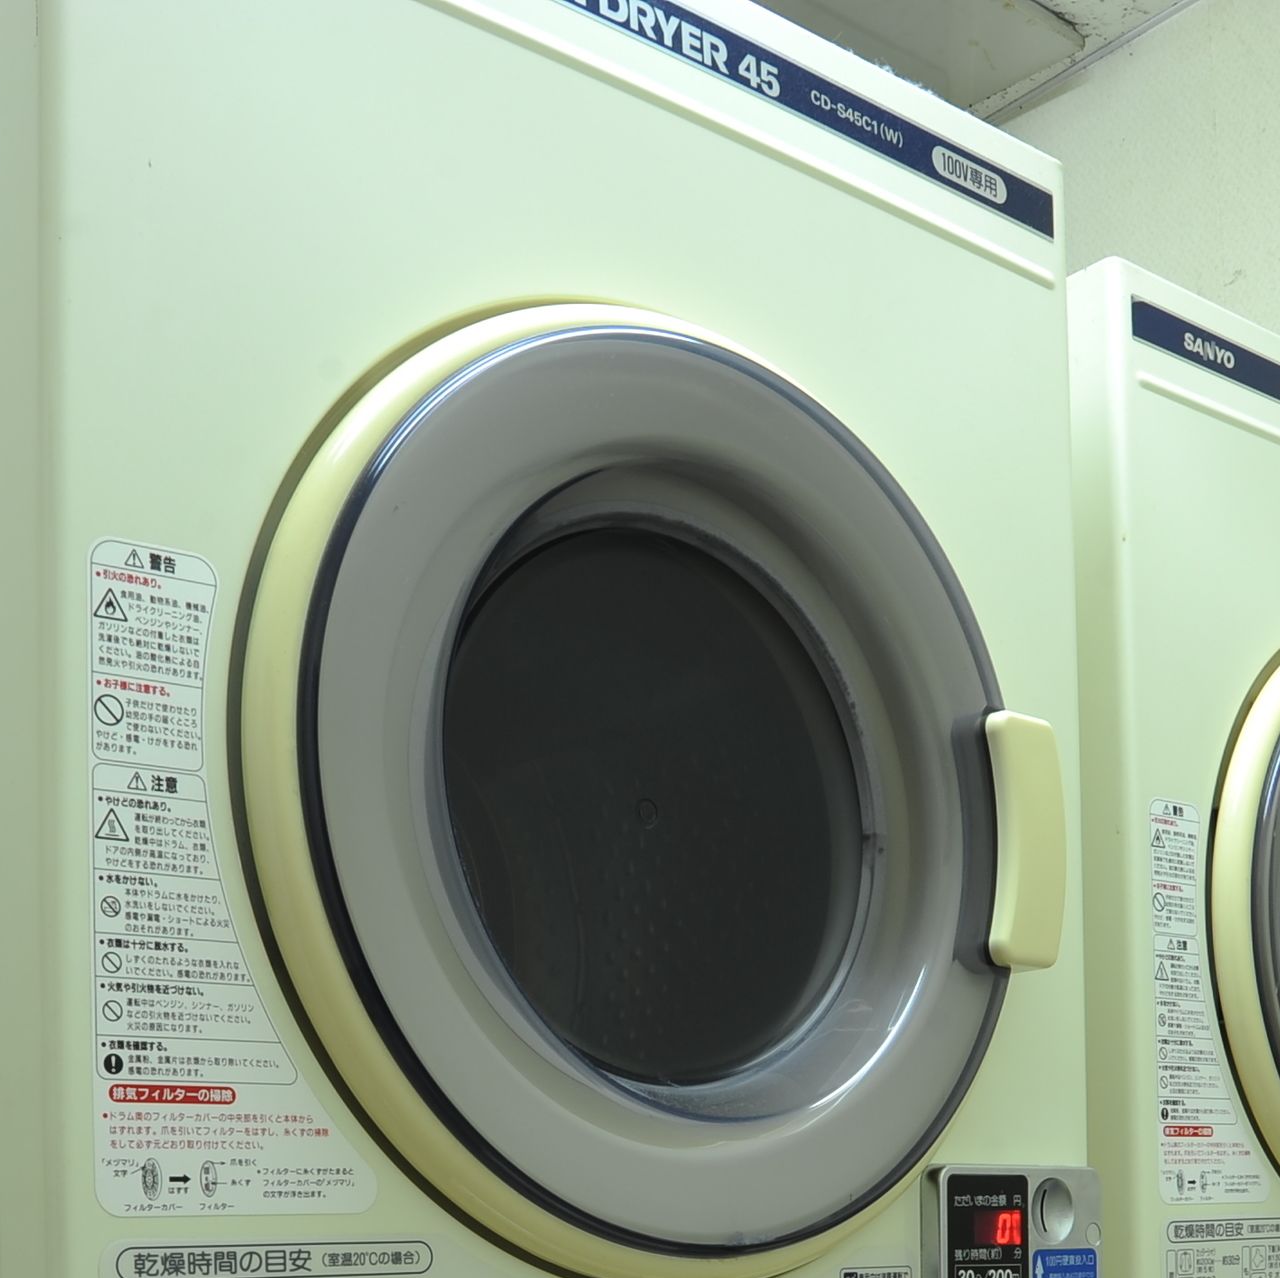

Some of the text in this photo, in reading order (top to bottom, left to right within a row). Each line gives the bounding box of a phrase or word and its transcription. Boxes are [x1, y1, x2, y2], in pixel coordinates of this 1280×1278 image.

[599, 0, 781, 98] DRYER 45
[811, 89, 904, 148] CD-S45C1(W)
[940, 151, 999, 198] 100V専用
[1184, 332, 1235, 369] SANYO
[149, 553, 176, 574] 警告
[151, 774, 178, 794] 注意
[112, 1086, 234, 1103] 排気フィルターの掃除
[124, 1202, 183, 1212] フィルターカバー
[200, 1202, 235, 1211] フィルター
[1174, 1222, 1244, 1239] 乾燥時間の目安
[133, 1250, 313, 1277] 乾燥時間の目安
